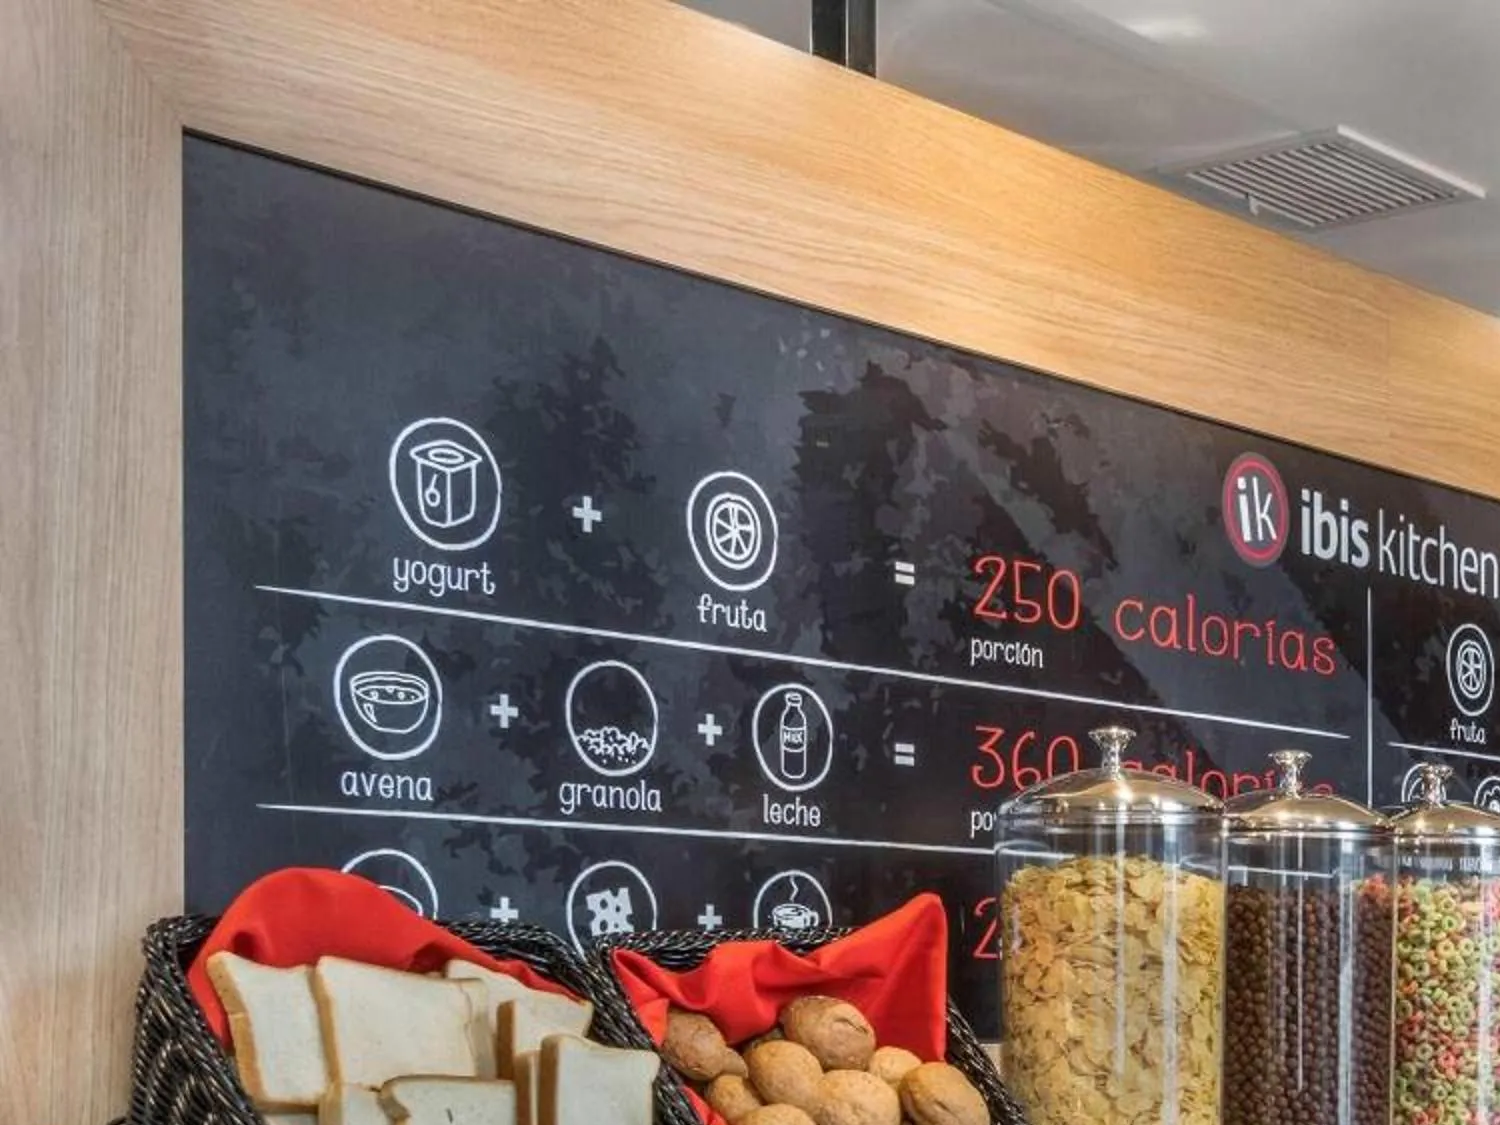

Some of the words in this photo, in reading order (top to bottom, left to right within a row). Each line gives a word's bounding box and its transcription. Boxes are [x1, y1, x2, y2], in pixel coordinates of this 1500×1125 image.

[1301, 488, 1370, 568] ibis
[1379, 508, 1499, 599] kitchen
[393, 556, 496, 596] yogurt
[973, 555, 1081, 631] 250
[697, 593, 767, 633] fruta
[971, 636, 1043, 668] porción
[1450, 717, 1487, 745] fruta
[971, 725, 1079, 792] 360
[341, 770, 433, 801] avena
[559, 780, 662, 816] granola
[763, 795, 821, 827] leche
